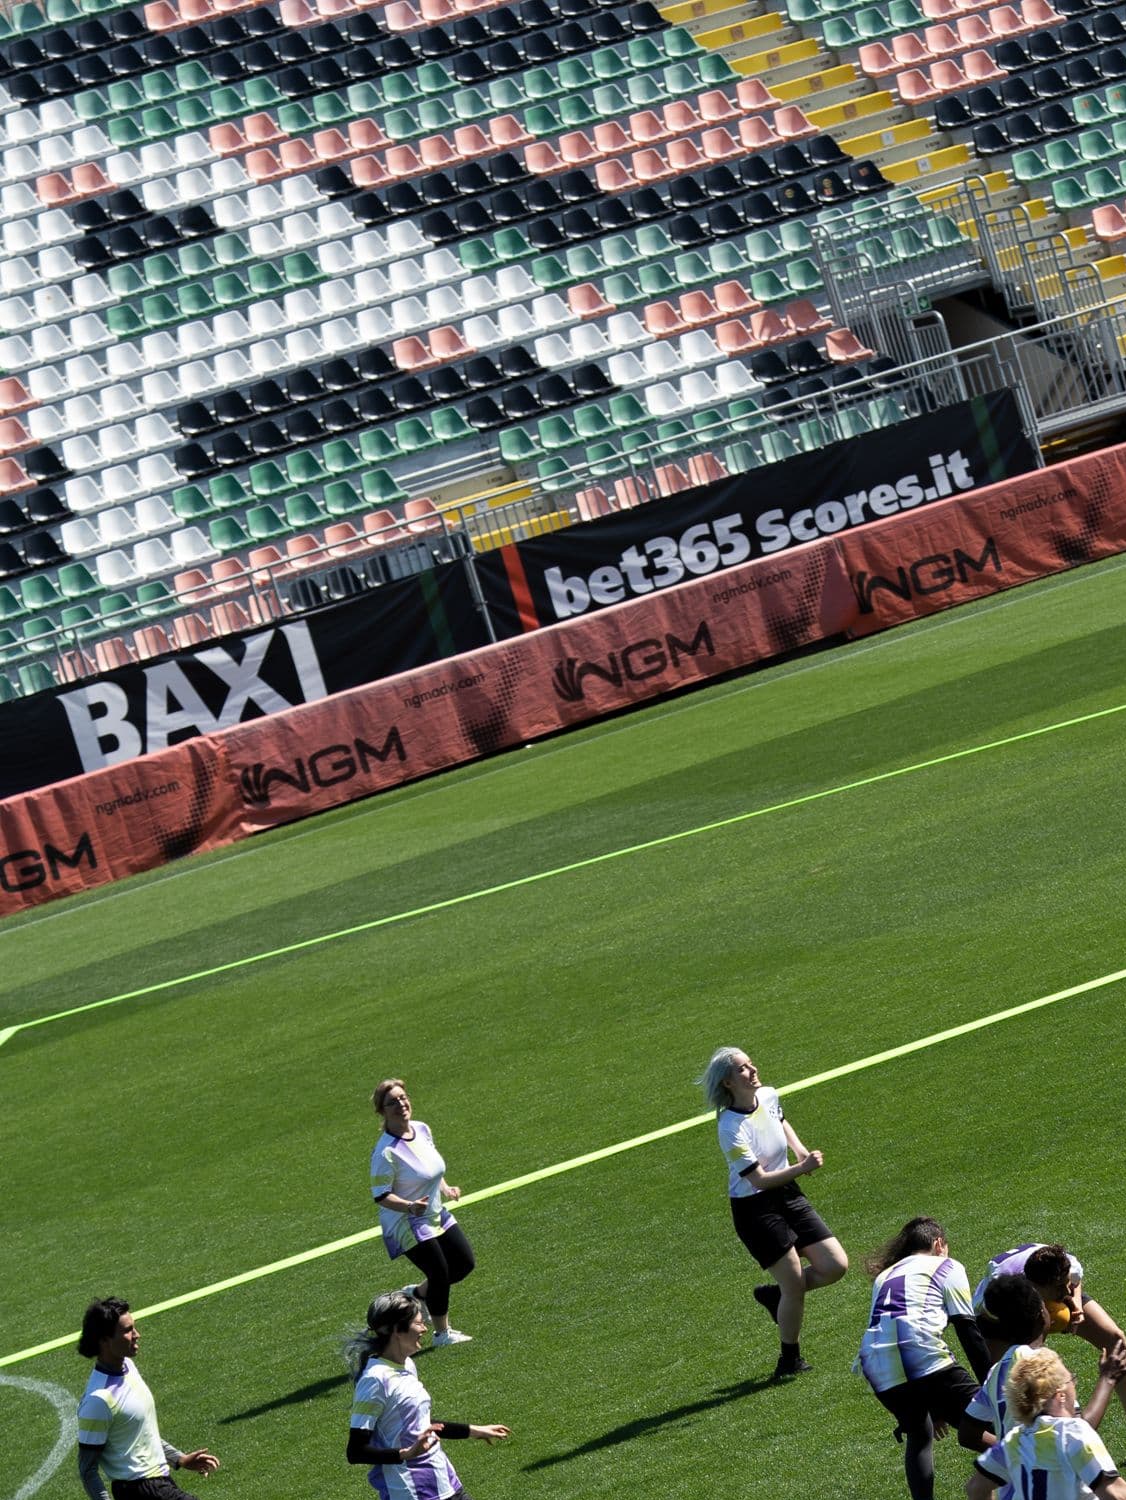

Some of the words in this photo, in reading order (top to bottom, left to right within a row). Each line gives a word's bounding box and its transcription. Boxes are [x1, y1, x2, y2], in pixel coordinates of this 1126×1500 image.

[543, 513, 751, 619] bet365
[755, 449, 975, 554] Scores.it
[1000, 487, 1077, 521] ngmadv.com
[712, 569, 792, 605] ngmadv.com
[852, 537, 1002, 615] NGM
[55, 620, 328, 775] BAXI
[403, 673, 486, 708] ngmadv.com
[552, 620, 715, 701] NGM
[240, 726, 407, 807] NGM
